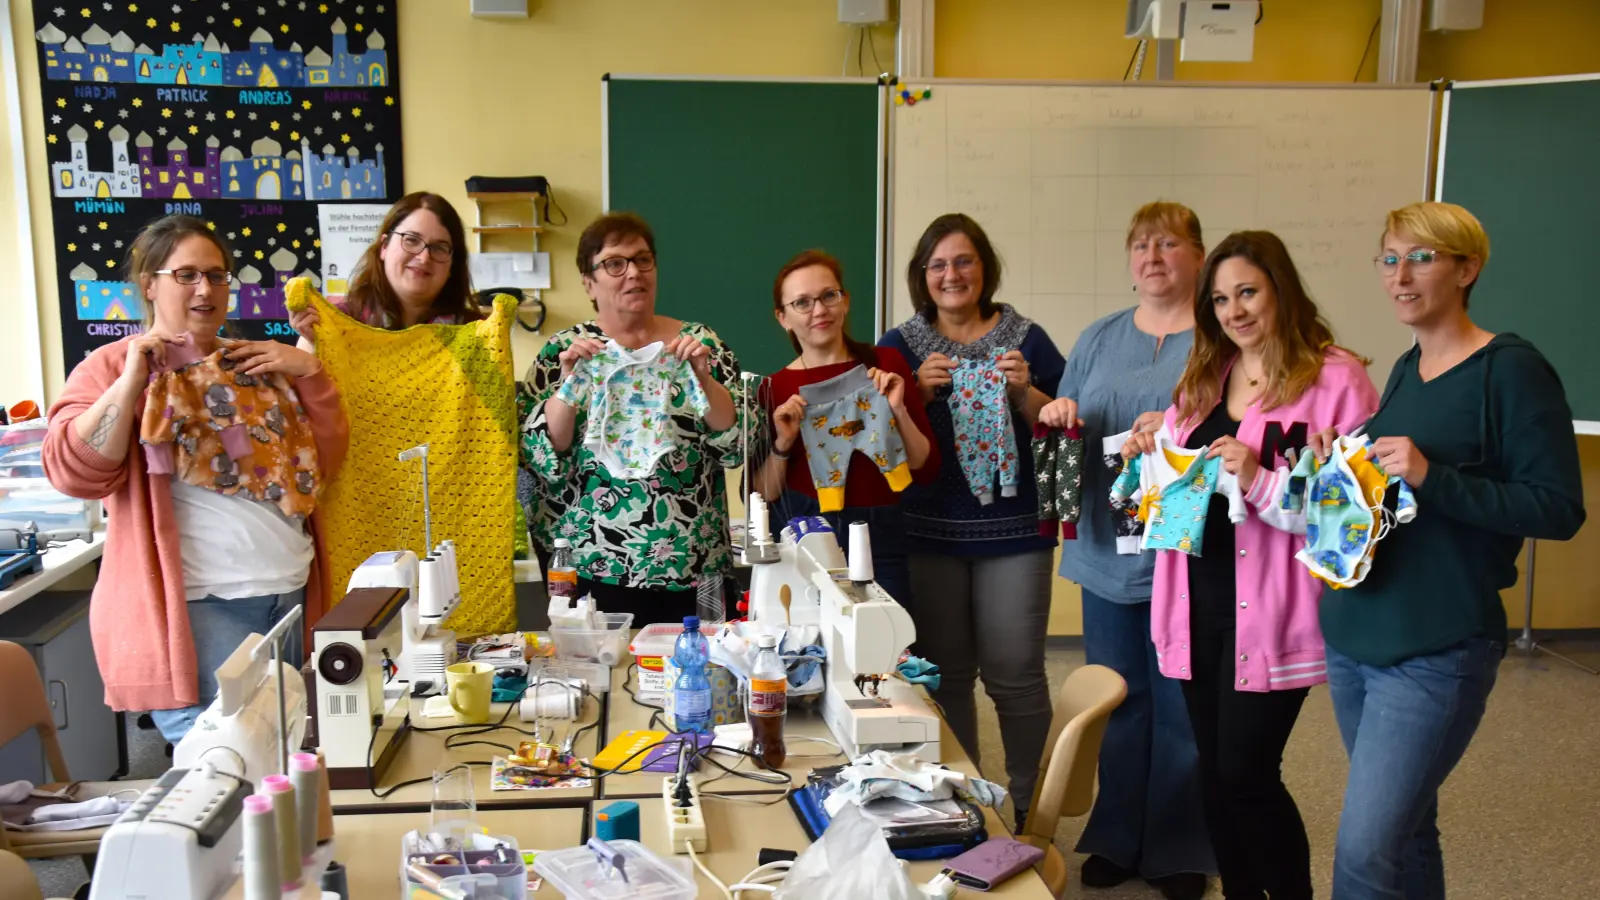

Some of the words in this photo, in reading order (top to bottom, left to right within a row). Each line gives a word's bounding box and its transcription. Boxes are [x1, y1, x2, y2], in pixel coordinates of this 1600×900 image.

[74, 86, 117, 100] NADJA
[156, 88, 209, 103] PATRICK
[238, 90, 293, 105] ANDREAS
[240, 203, 284, 218] JULIAN
[329, 213, 351, 221] Stühle
[1259, 421, 1308, 472] M
